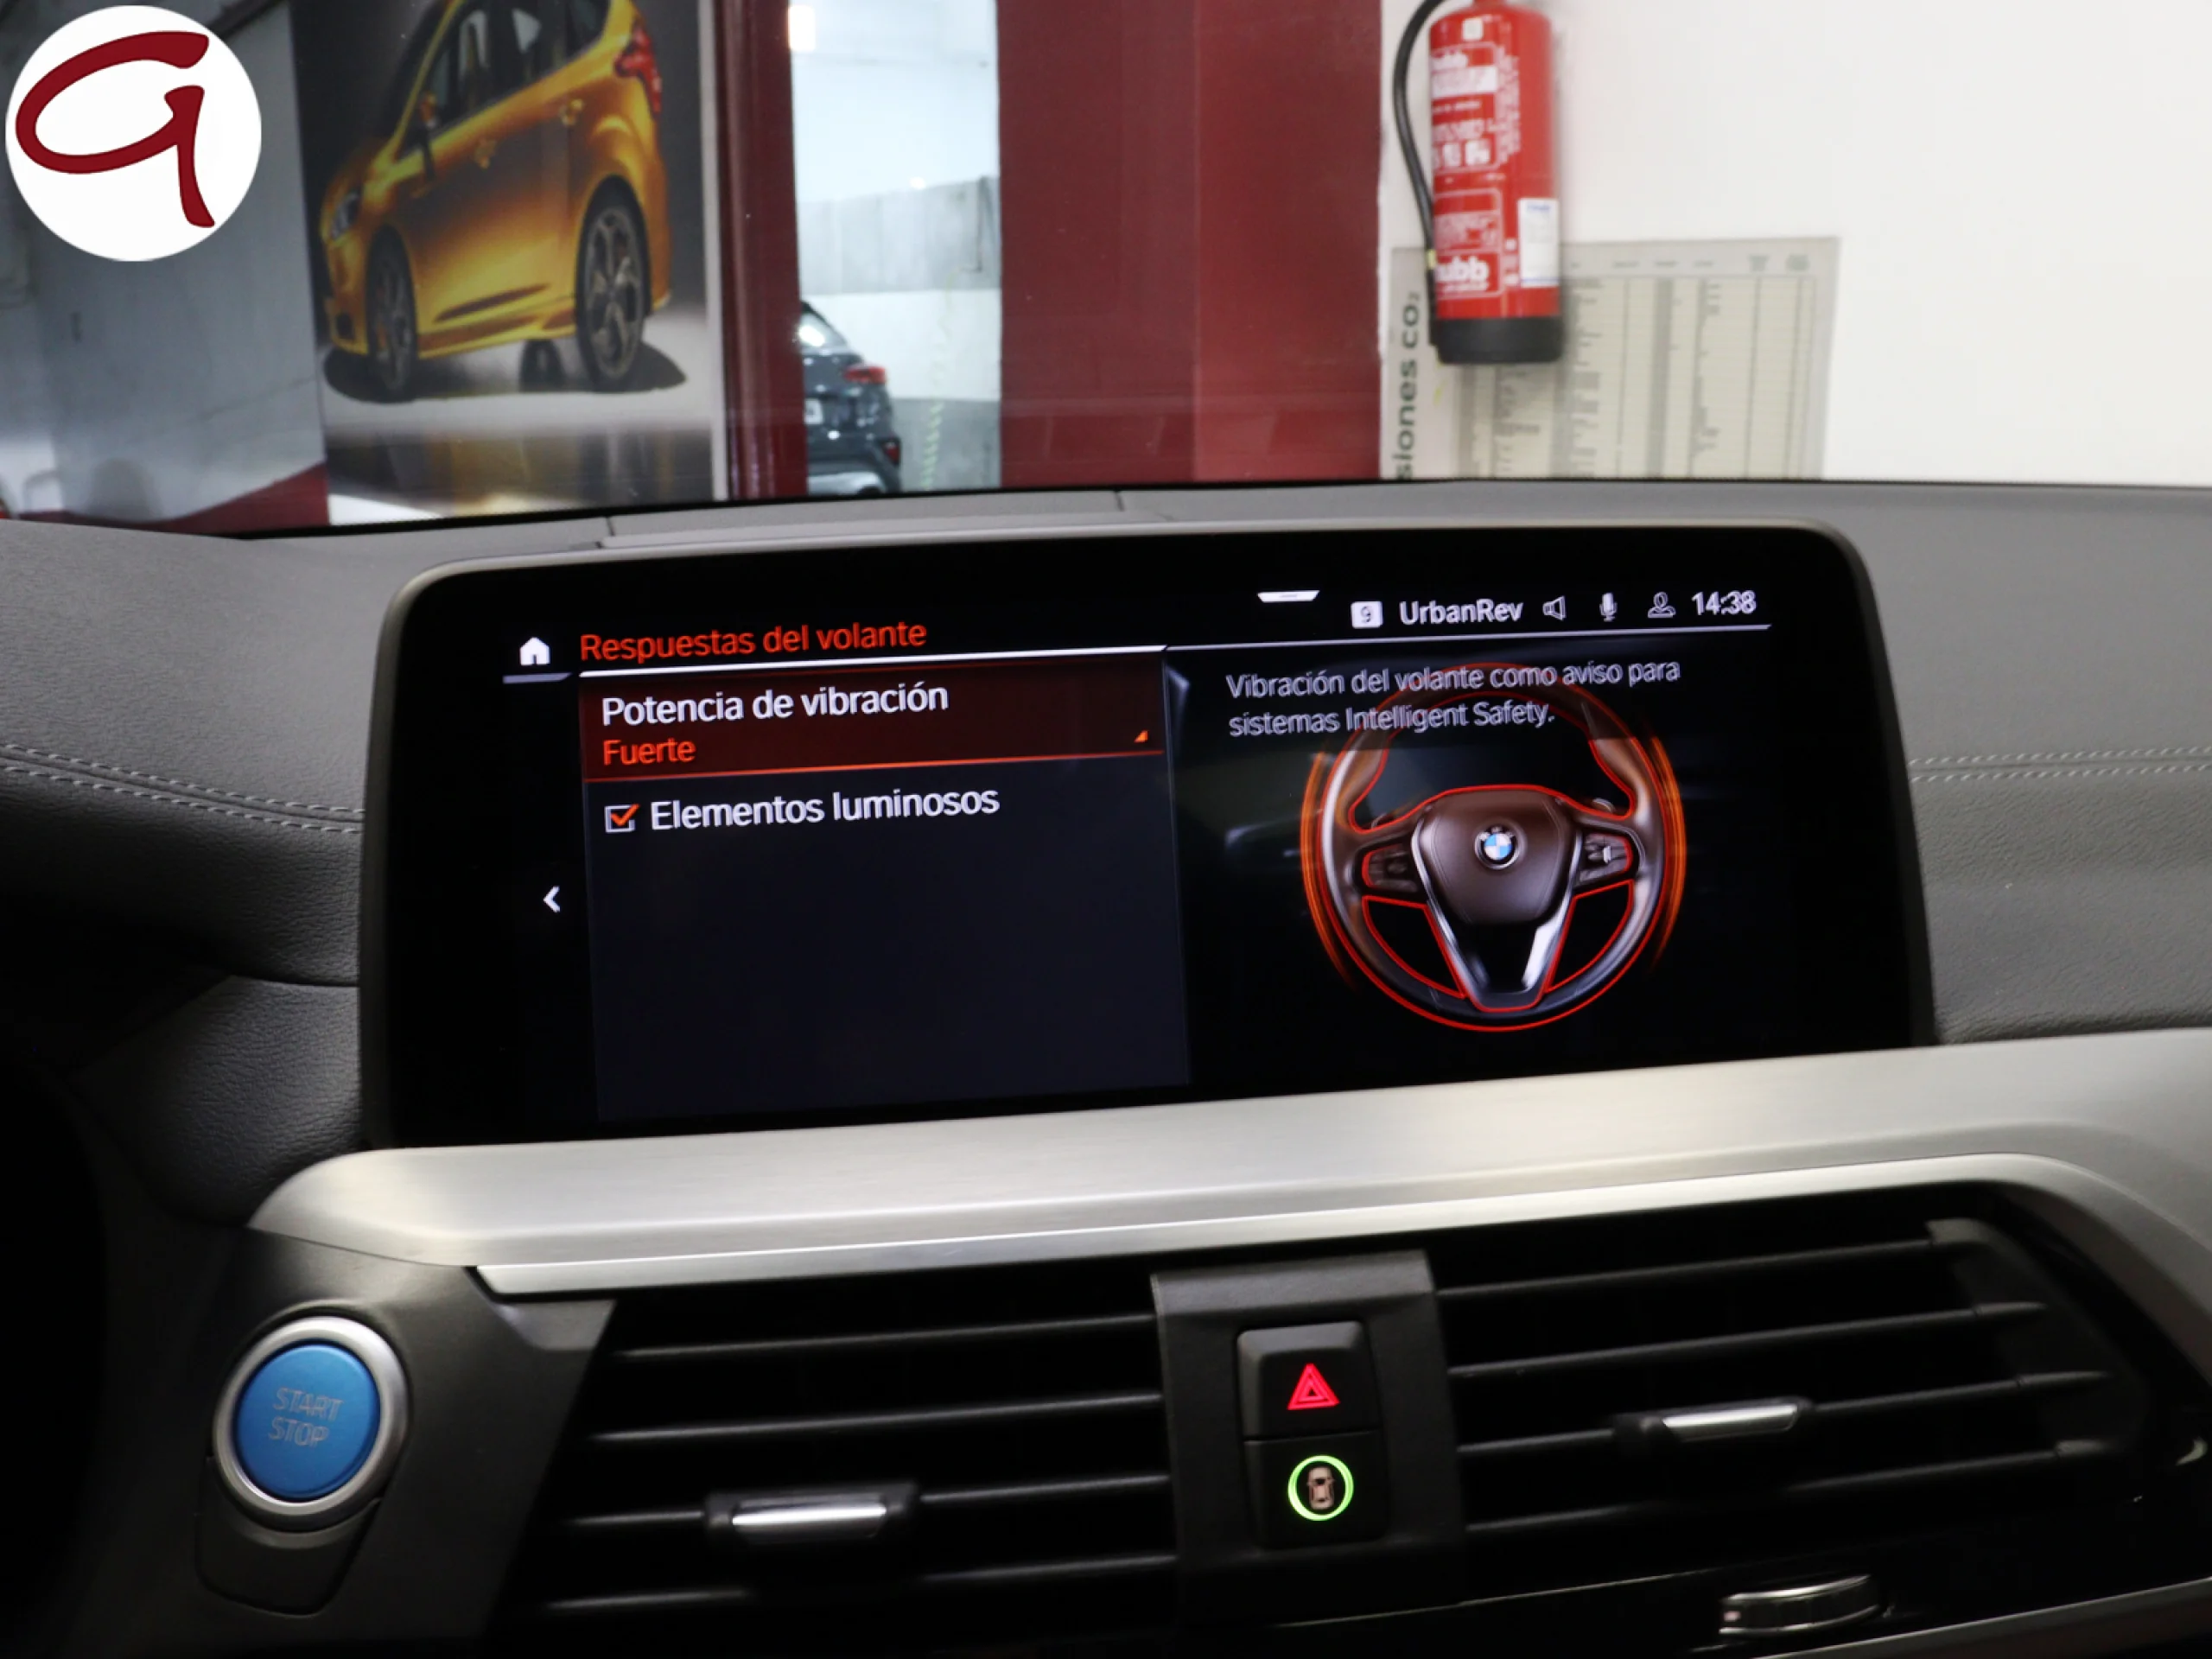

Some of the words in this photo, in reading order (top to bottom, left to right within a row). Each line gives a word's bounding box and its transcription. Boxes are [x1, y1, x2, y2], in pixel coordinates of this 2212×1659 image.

[1399, 599, 1523, 626] UrbanRev
[1691, 590, 1757, 616] 14:38
[580, 631, 756, 664] Respuestas
[762, 626, 810, 652] del
[817, 622, 927, 650] volante
[1226, 671, 1345, 698] Vibración
[1351, 670, 1390, 694] del
[1394, 664, 1484, 692] volante
[1490, 668, 1557, 688] como
[1561, 659, 1623, 687] aviso
[1629, 662, 1681, 688] para
[601, 692, 744, 726] Potencia
[752, 690, 794, 719] de
[800, 682, 949, 716] vibración
[1229, 710, 1340, 737] sistemas
[1345, 703, 1469, 734] Intelligent
[1473, 701, 1554, 728] Safety.
[602, 737, 696, 766] Fuerte
[651, 797, 825, 830] Elementos
[832, 790, 1001, 822] luminosos
[274, 1388, 342, 1421] START
[268, 1416, 330, 1446] STOP
